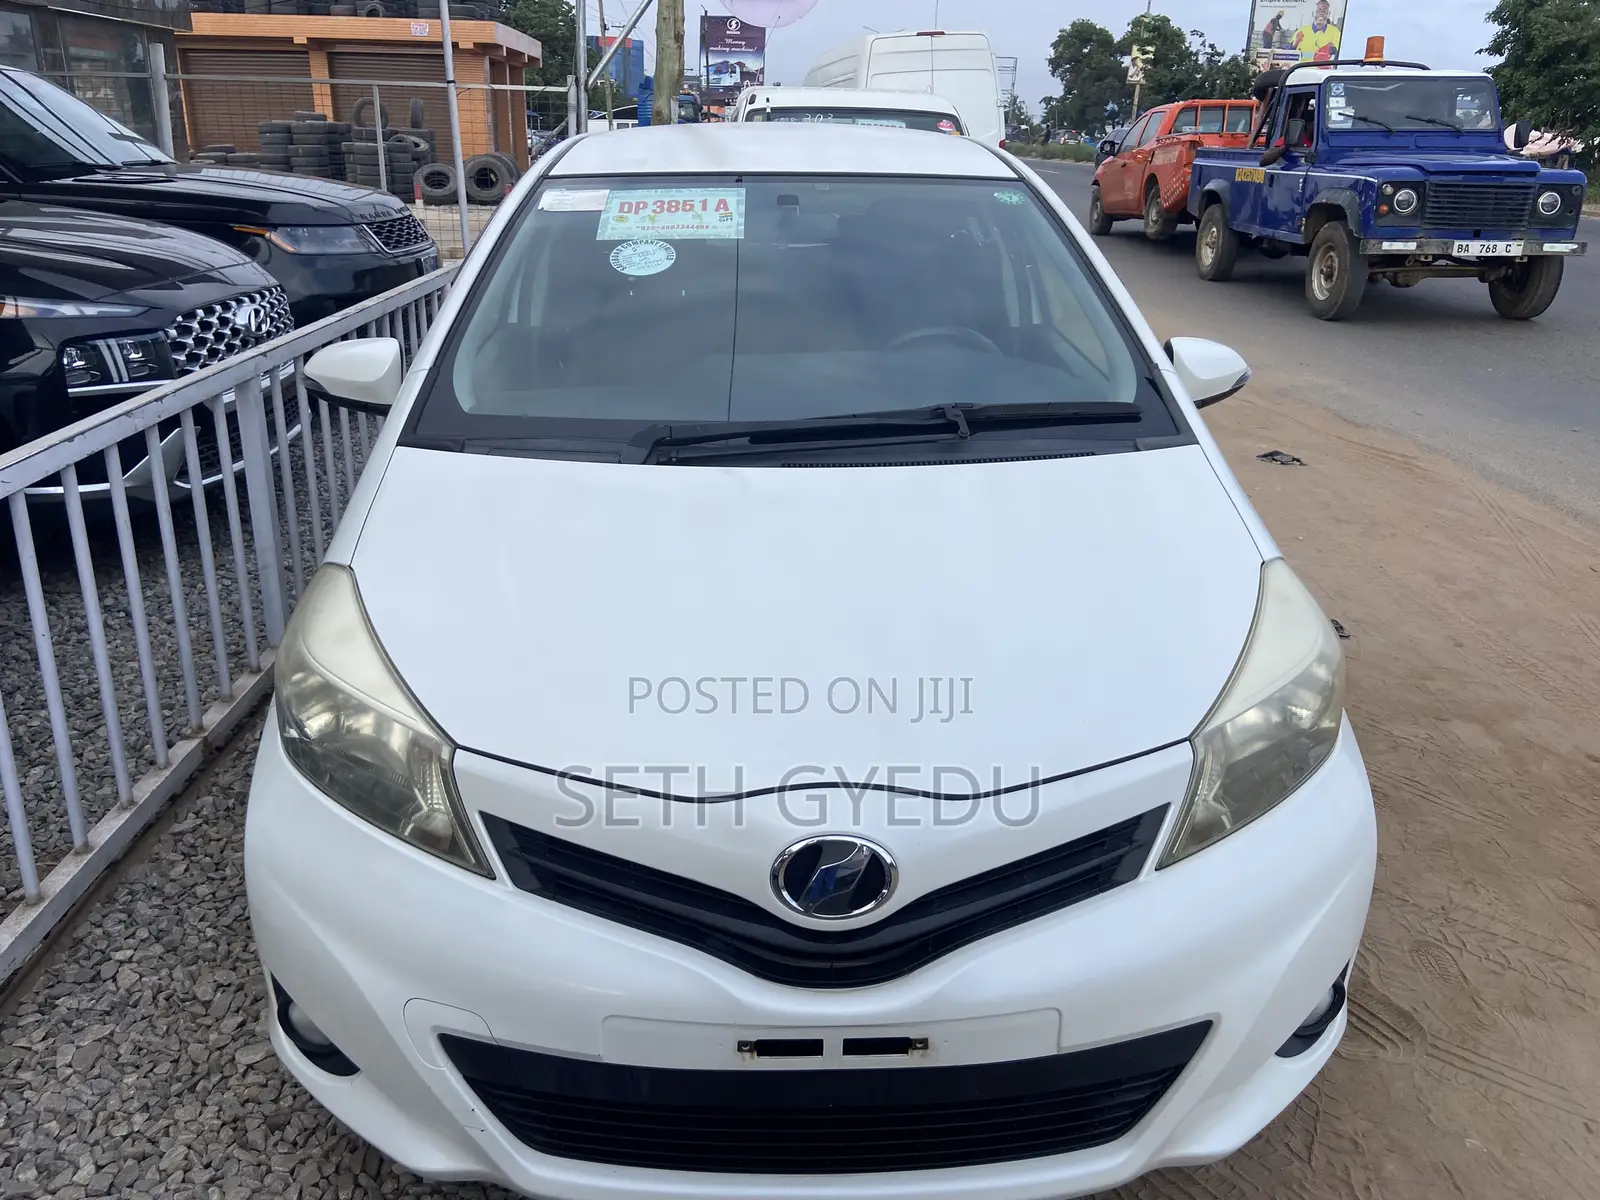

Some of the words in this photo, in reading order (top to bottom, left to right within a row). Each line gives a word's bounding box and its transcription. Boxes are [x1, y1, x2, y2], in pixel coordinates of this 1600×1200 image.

[618, 201, 649, 215] DP
[714, 198, 730, 212] A
[1456, 243, 1470, 254] BA
[1479, 243, 1498, 254] 768
[1505, 243, 1512, 254] C
